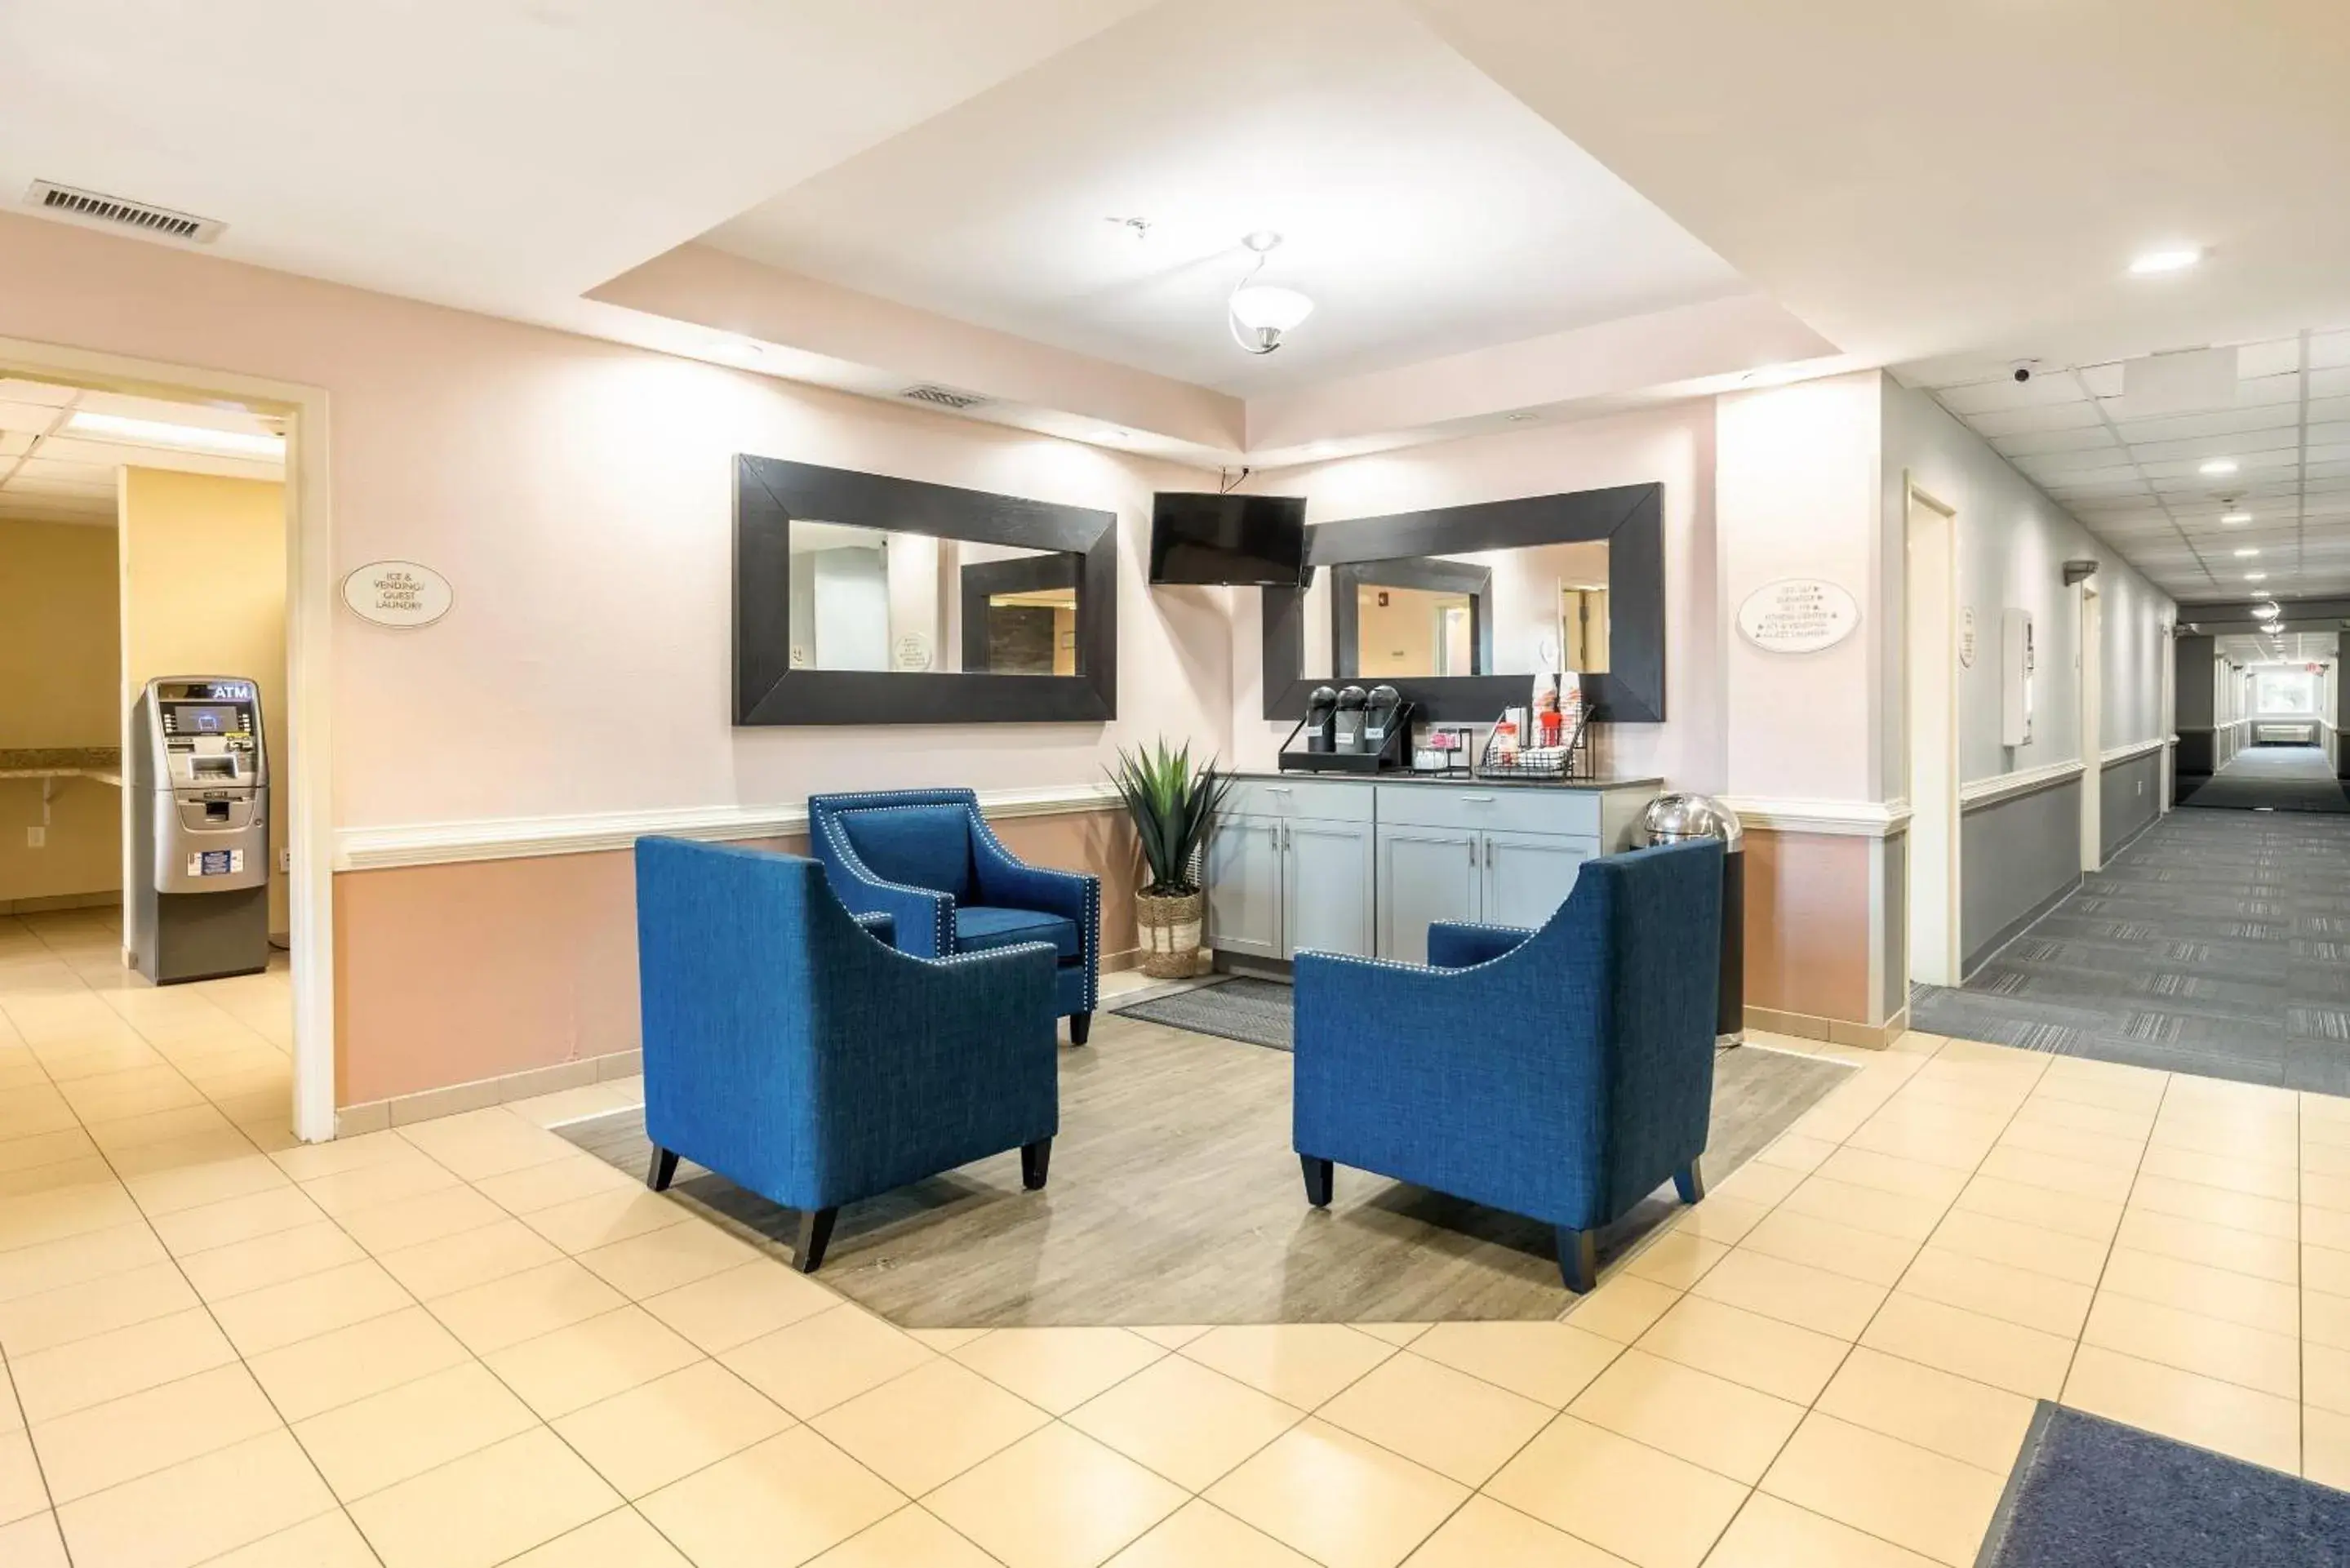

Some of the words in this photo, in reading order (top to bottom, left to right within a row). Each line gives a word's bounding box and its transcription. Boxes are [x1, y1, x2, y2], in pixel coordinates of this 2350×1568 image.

[386, 572, 402, 580] ICE
[404, 573, 412, 581] &
[384, 591, 415, 600] GUEST
[375, 601, 422, 610] LAUNDRY
[213, 686, 248, 699] ATM
